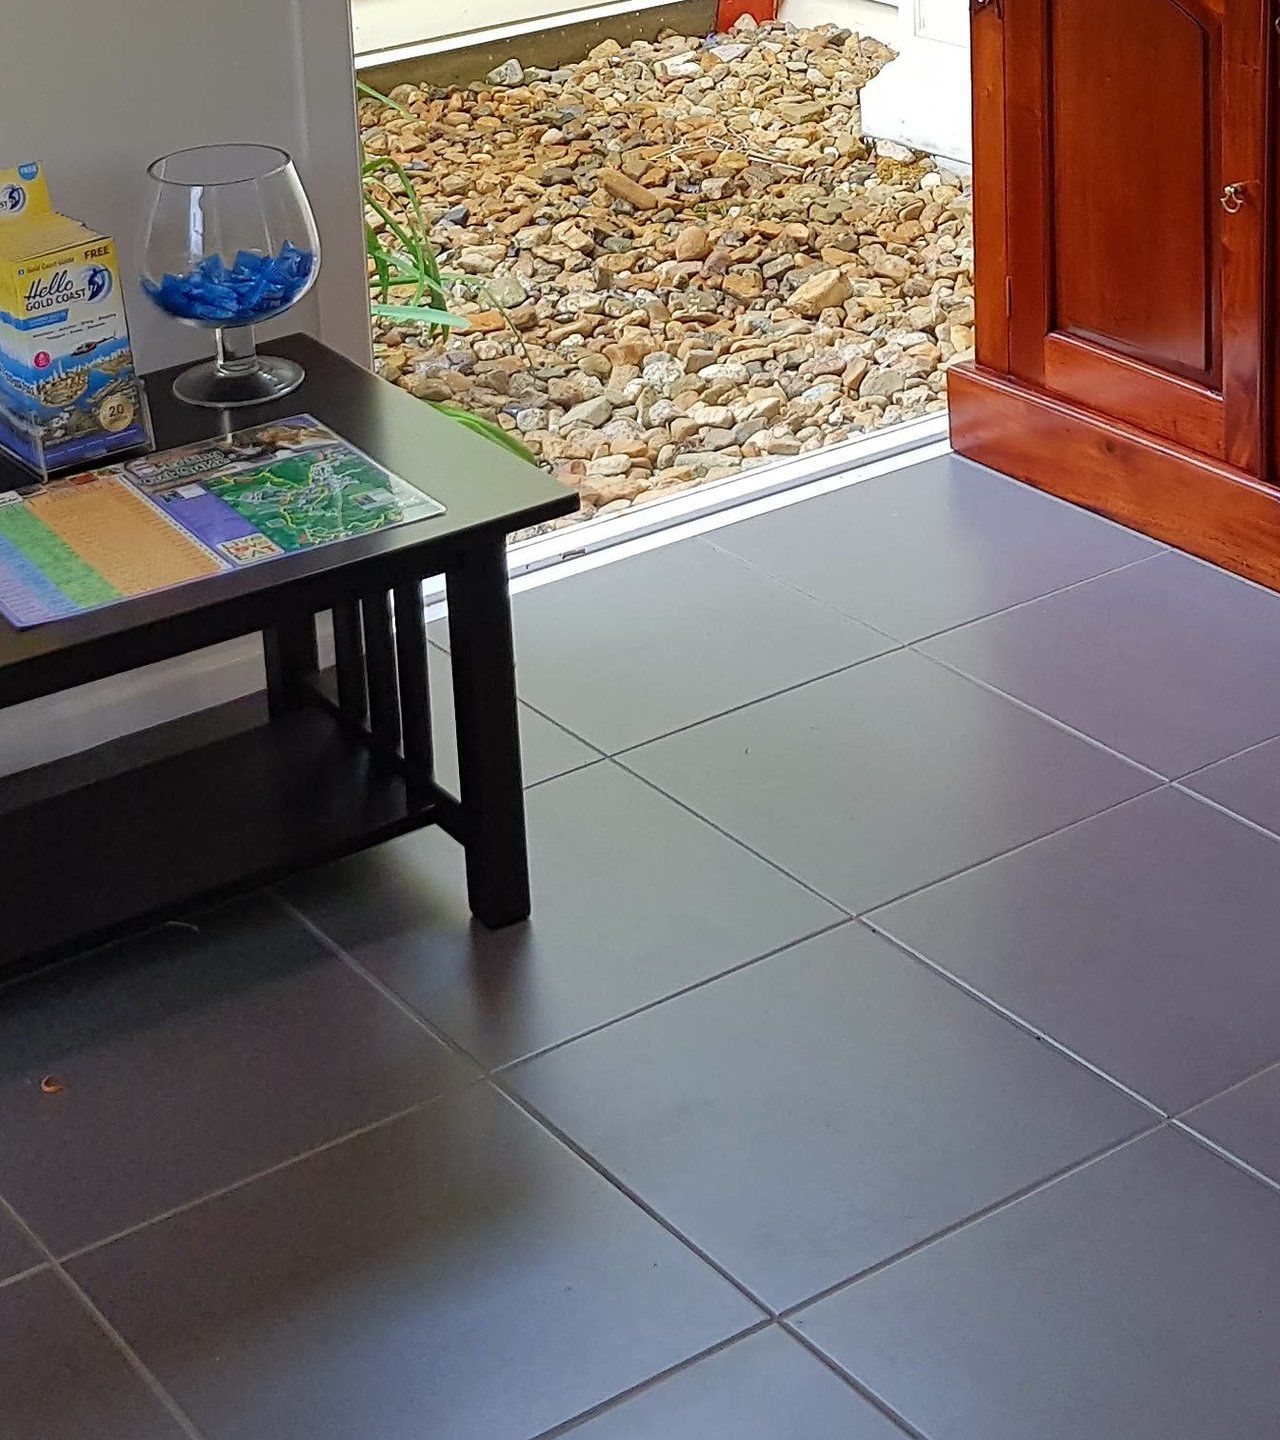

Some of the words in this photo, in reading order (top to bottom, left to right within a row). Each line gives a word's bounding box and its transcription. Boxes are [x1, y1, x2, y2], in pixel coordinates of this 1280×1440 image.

[83, 244, 111, 261] FREE
[23, 269, 75, 302] Hello
[25, 296, 54, 313] GOLD
[55, 288, 86, 305] COAST
[108, 404, 126, 417] 20
